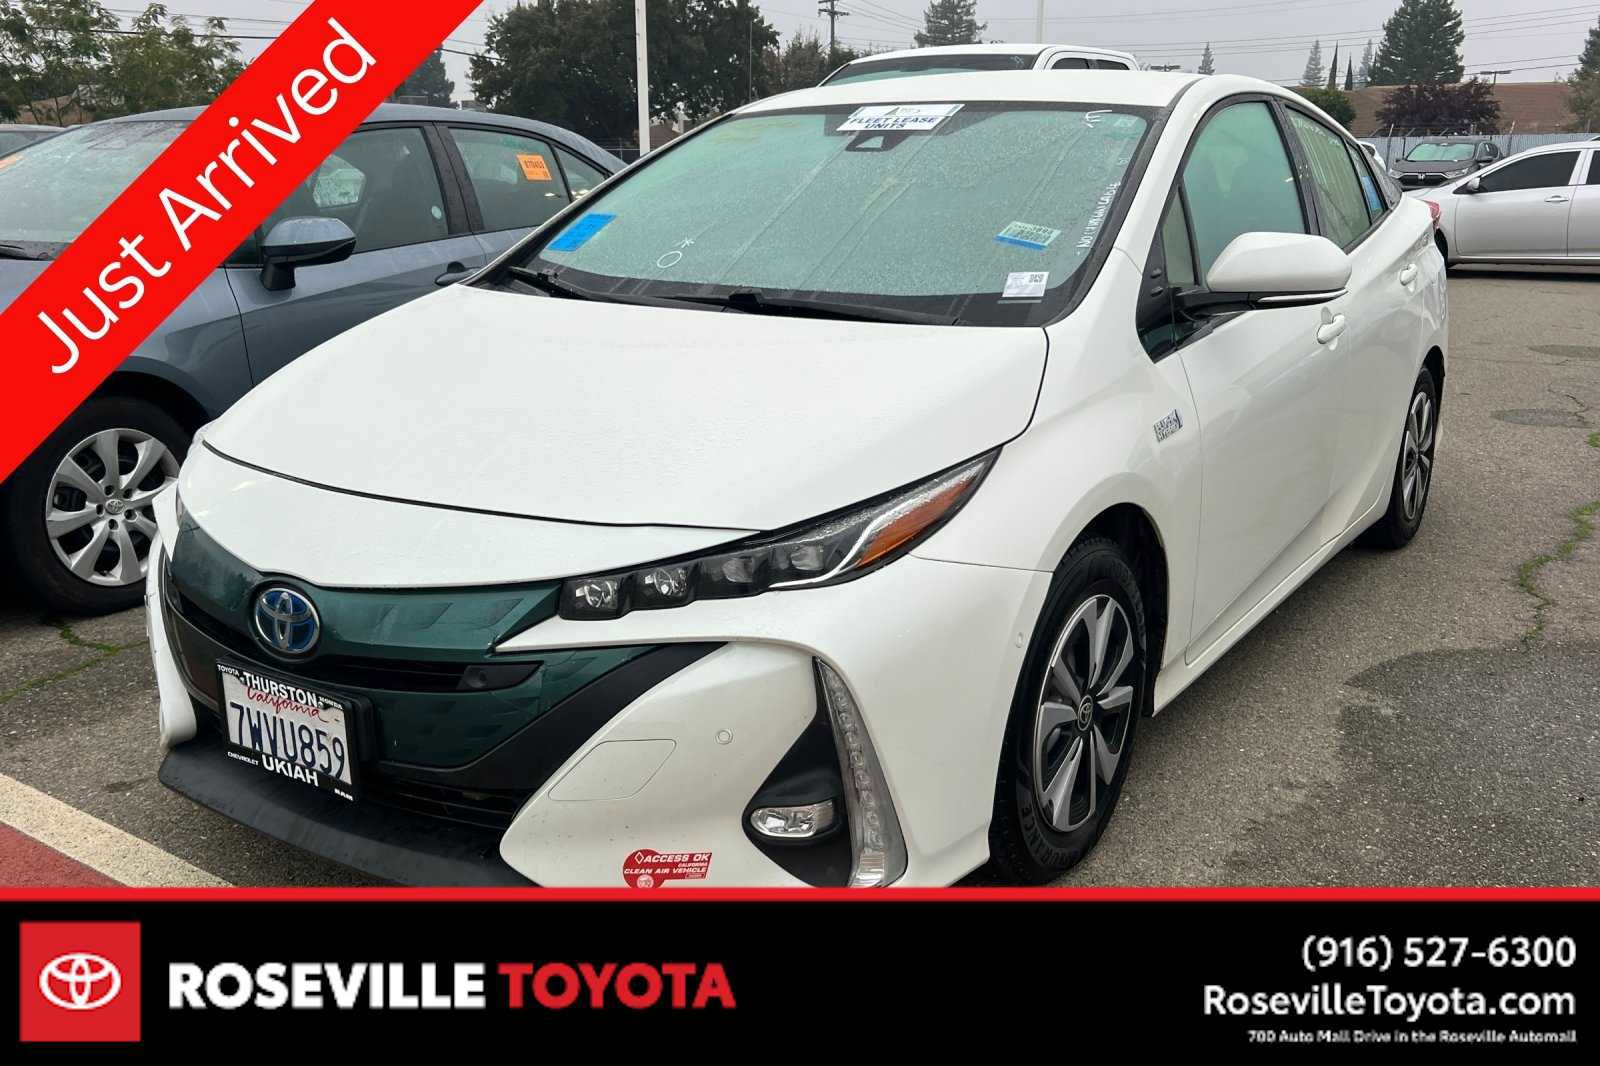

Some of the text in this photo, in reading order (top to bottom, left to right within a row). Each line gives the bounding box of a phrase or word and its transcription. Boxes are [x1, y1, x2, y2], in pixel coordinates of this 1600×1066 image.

[849, 116, 938, 124] FLEET LEASE
[217, 664, 240, 677] TOYOTA
[243, 672, 319, 708] THURSTON
[246, 686, 330, 724] California
[229, 701, 345, 780] 7WVU859
[227, 751, 259, 766] CHEVROLET
[262, 754, 319, 787] UKIAH
[643, 853, 711, 863] ACCESS OK
